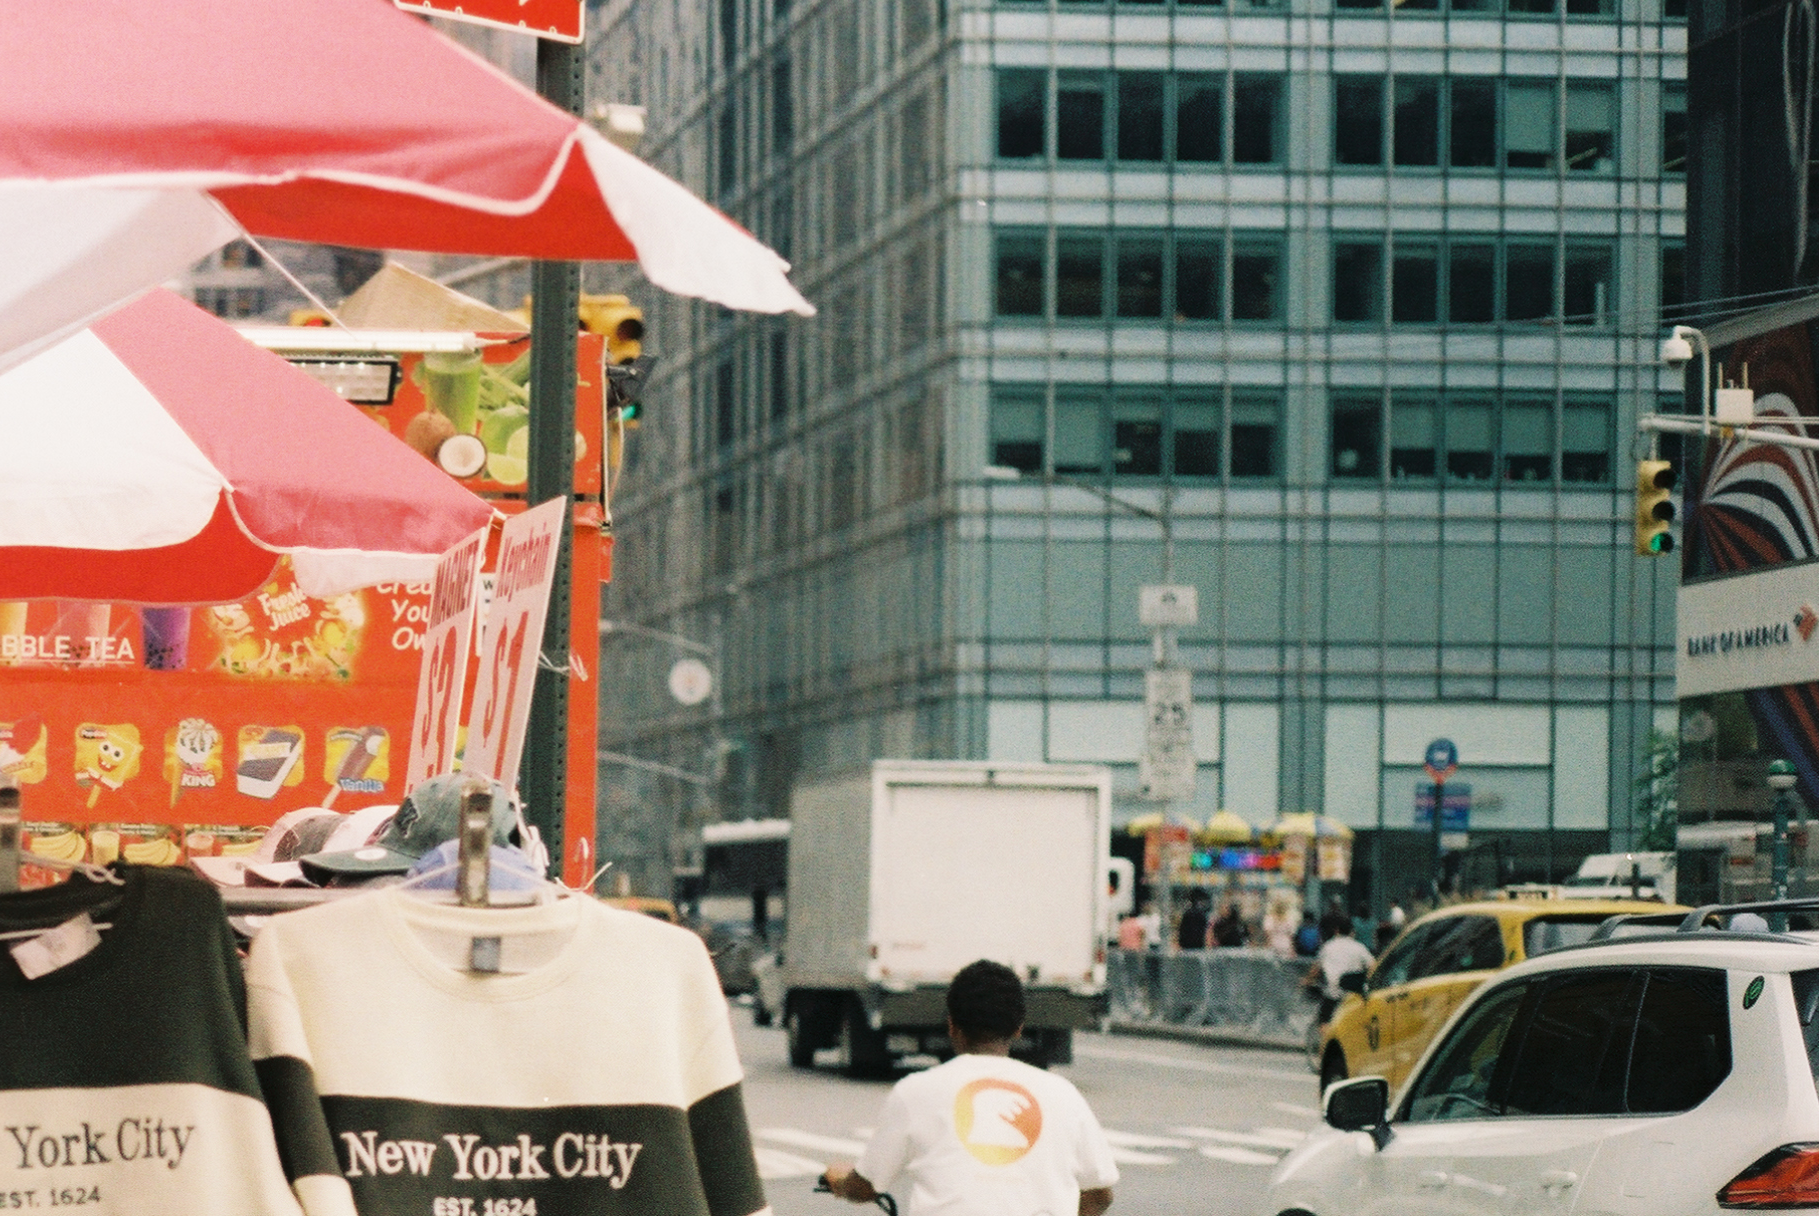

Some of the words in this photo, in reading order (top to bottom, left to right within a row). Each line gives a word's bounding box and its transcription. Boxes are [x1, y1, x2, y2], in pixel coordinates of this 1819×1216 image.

[429, 538, 480, 630] MAGNET
[496, 522, 552, 603] Keychain
[257, 582, 307, 616] Fresh
[269, 602, 312, 631] Juice
[85, 635, 136, 661] TEA
[483, 610, 530, 780] $1
[5, 1121, 112, 1170] York
[116, 1117, 196, 1170] City
[340, 1130, 437, 1178] New
[442, 1133, 551, 1181] York
[552, 1131, 644, 1190] City
[49, 1185, 102, 1207] 1624
